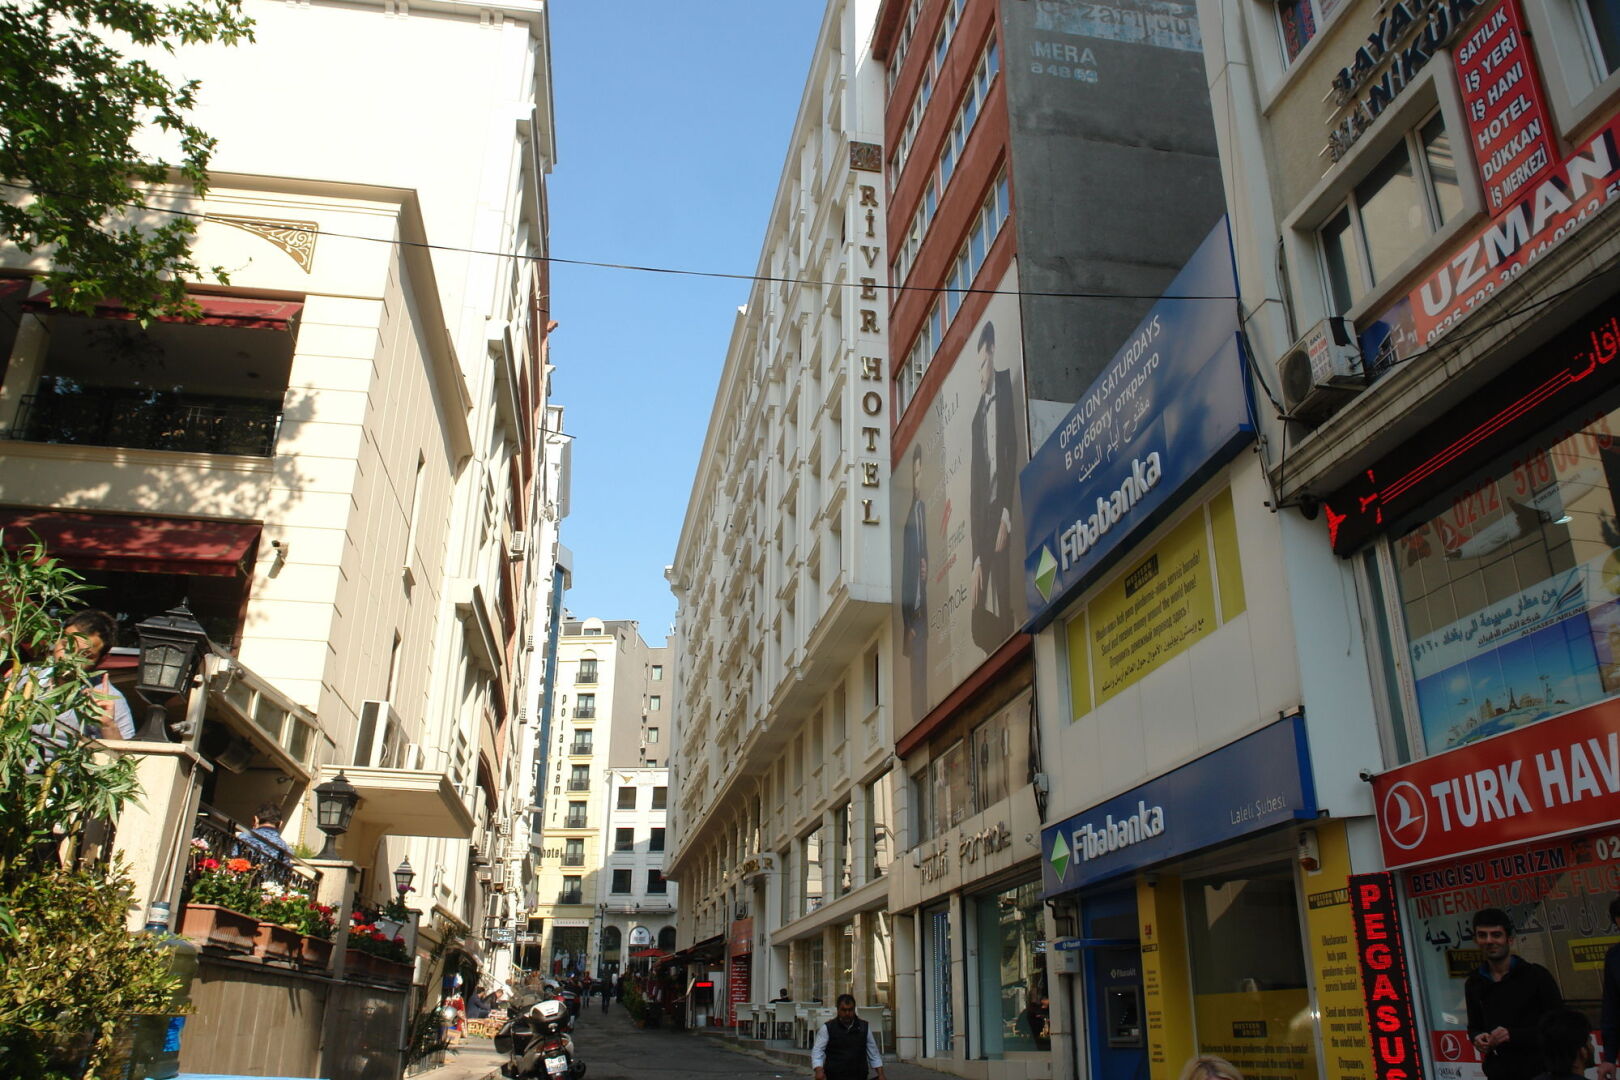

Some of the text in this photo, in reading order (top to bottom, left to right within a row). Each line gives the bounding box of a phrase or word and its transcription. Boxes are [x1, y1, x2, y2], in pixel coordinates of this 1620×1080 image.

[1459, 6, 1508, 66] SATILIK
[1464, 28, 1518, 93] İŞ YERİ
[1470, 61, 1524, 122] İŞ HANI
[1477, 93, 1532, 151] HOTEL
[1482, 118, 1542, 181] DÜKKAN
[1490, 142, 1548, 209] İŞ MERKEZİ
[1419, 132, 1614, 317] UZMAN
[858, 184, 883, 526] RİVER HOTEL
[1059, 313, 1161, 450] OPEN ON SATURDAYS
[1064, 352, 1160, 471] В субботу открыто
[1060, 451, 1162, 571] Fibabanka
[552, 693, 567, 823] polatdemir
[1430, 731, 1620, 833] TURK HAV
[542, 845, 564, 859] hotel
[1071, 800, 1165, 865] Fibabanka
[1255, 791, 1288, 822] Şubesi
[1412, 862, 1487, 894] BENGİSU
[1489, 846, 1567, 878] TURİZM
[1415, 871, 1569, 920] INTERNATIONAL
[1326, 1005, 1364, 1018] Send and receive
[1330, 1022, 1346, 1035] money
[1331, 1036, 1339, 1047] the
